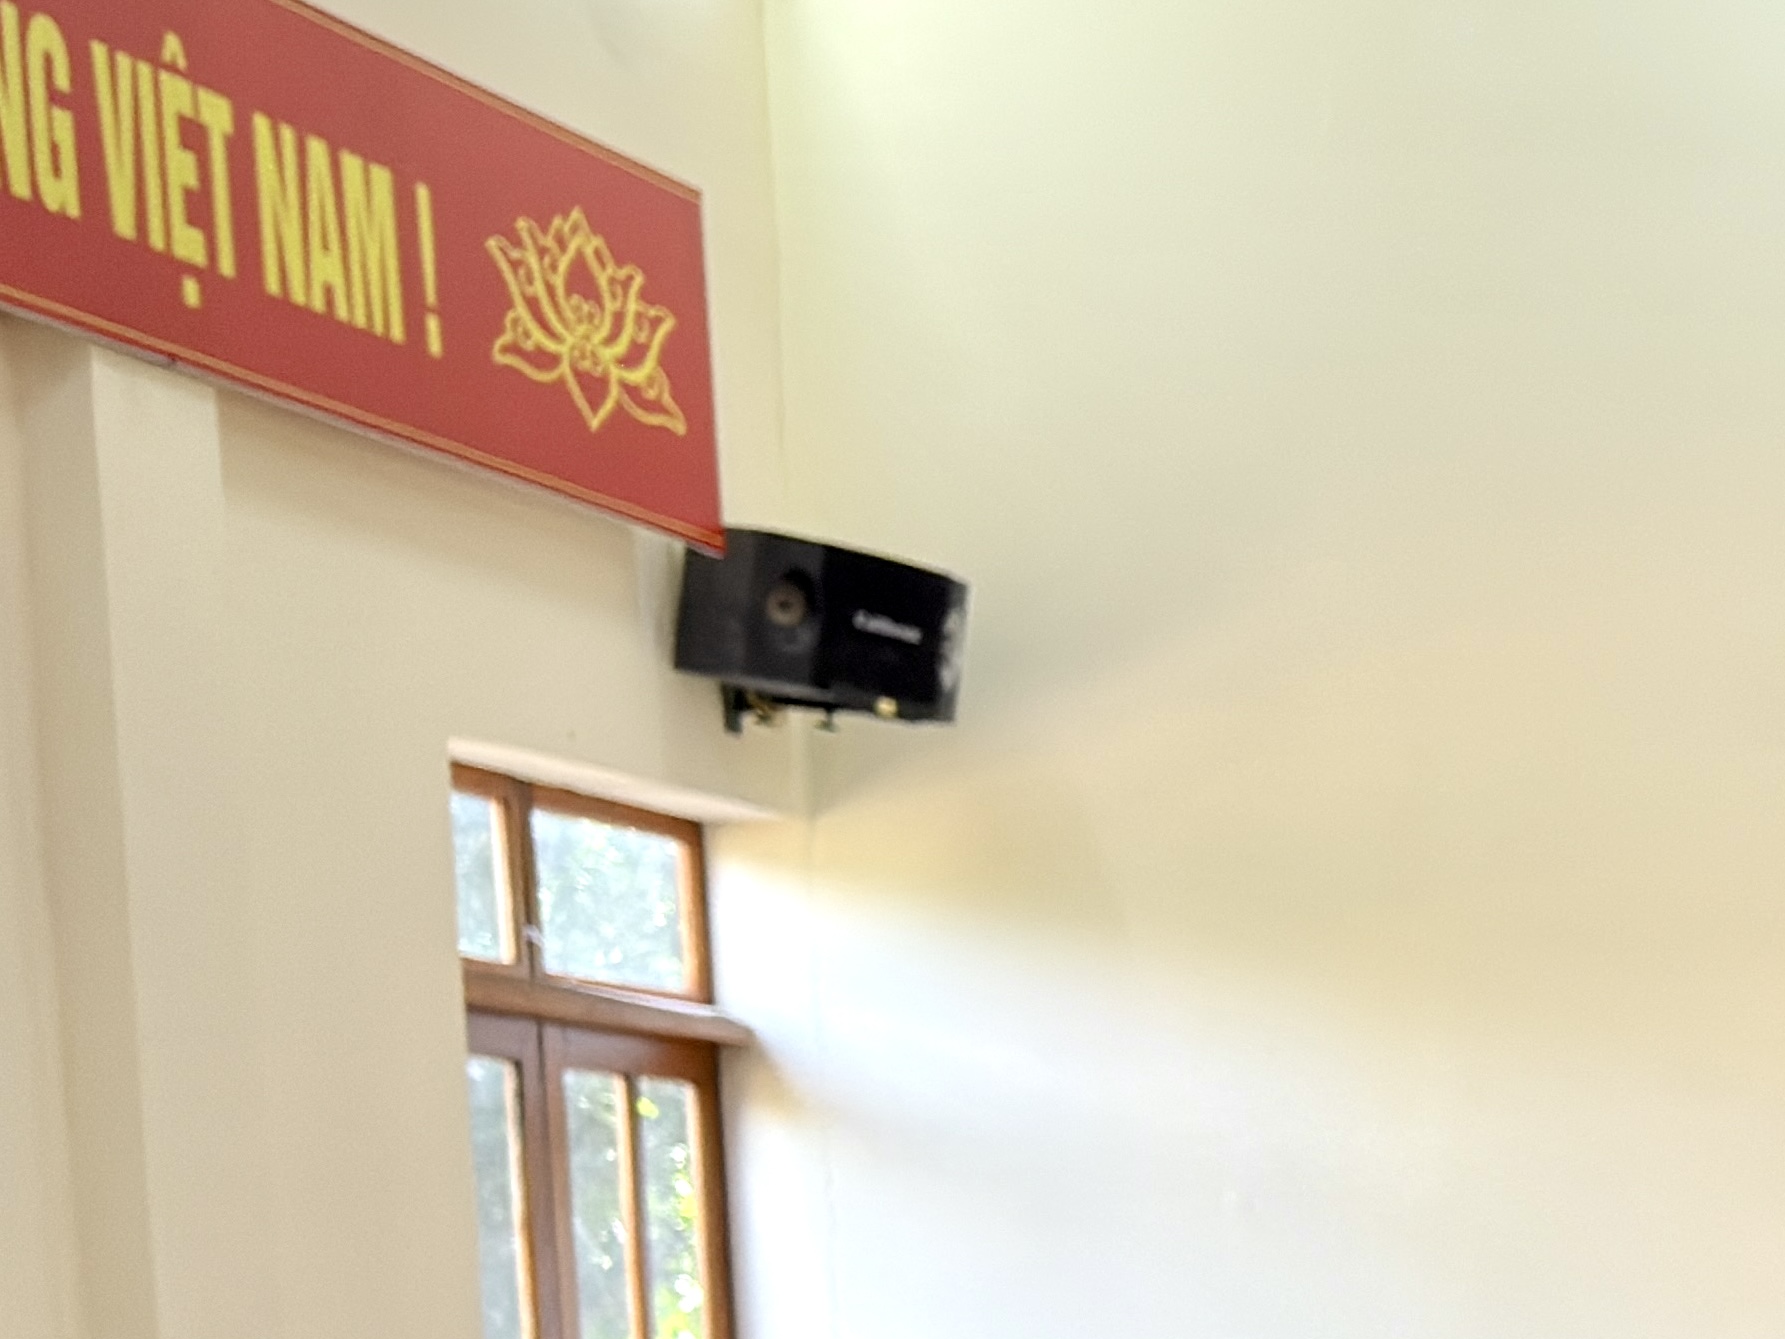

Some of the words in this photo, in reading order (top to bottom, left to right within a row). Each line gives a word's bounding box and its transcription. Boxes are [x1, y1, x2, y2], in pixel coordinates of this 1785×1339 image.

[90, 31, 236, 308] VIỆT
[251, 112, 406, 344] NAM
[415, 183, 443, 358] !
